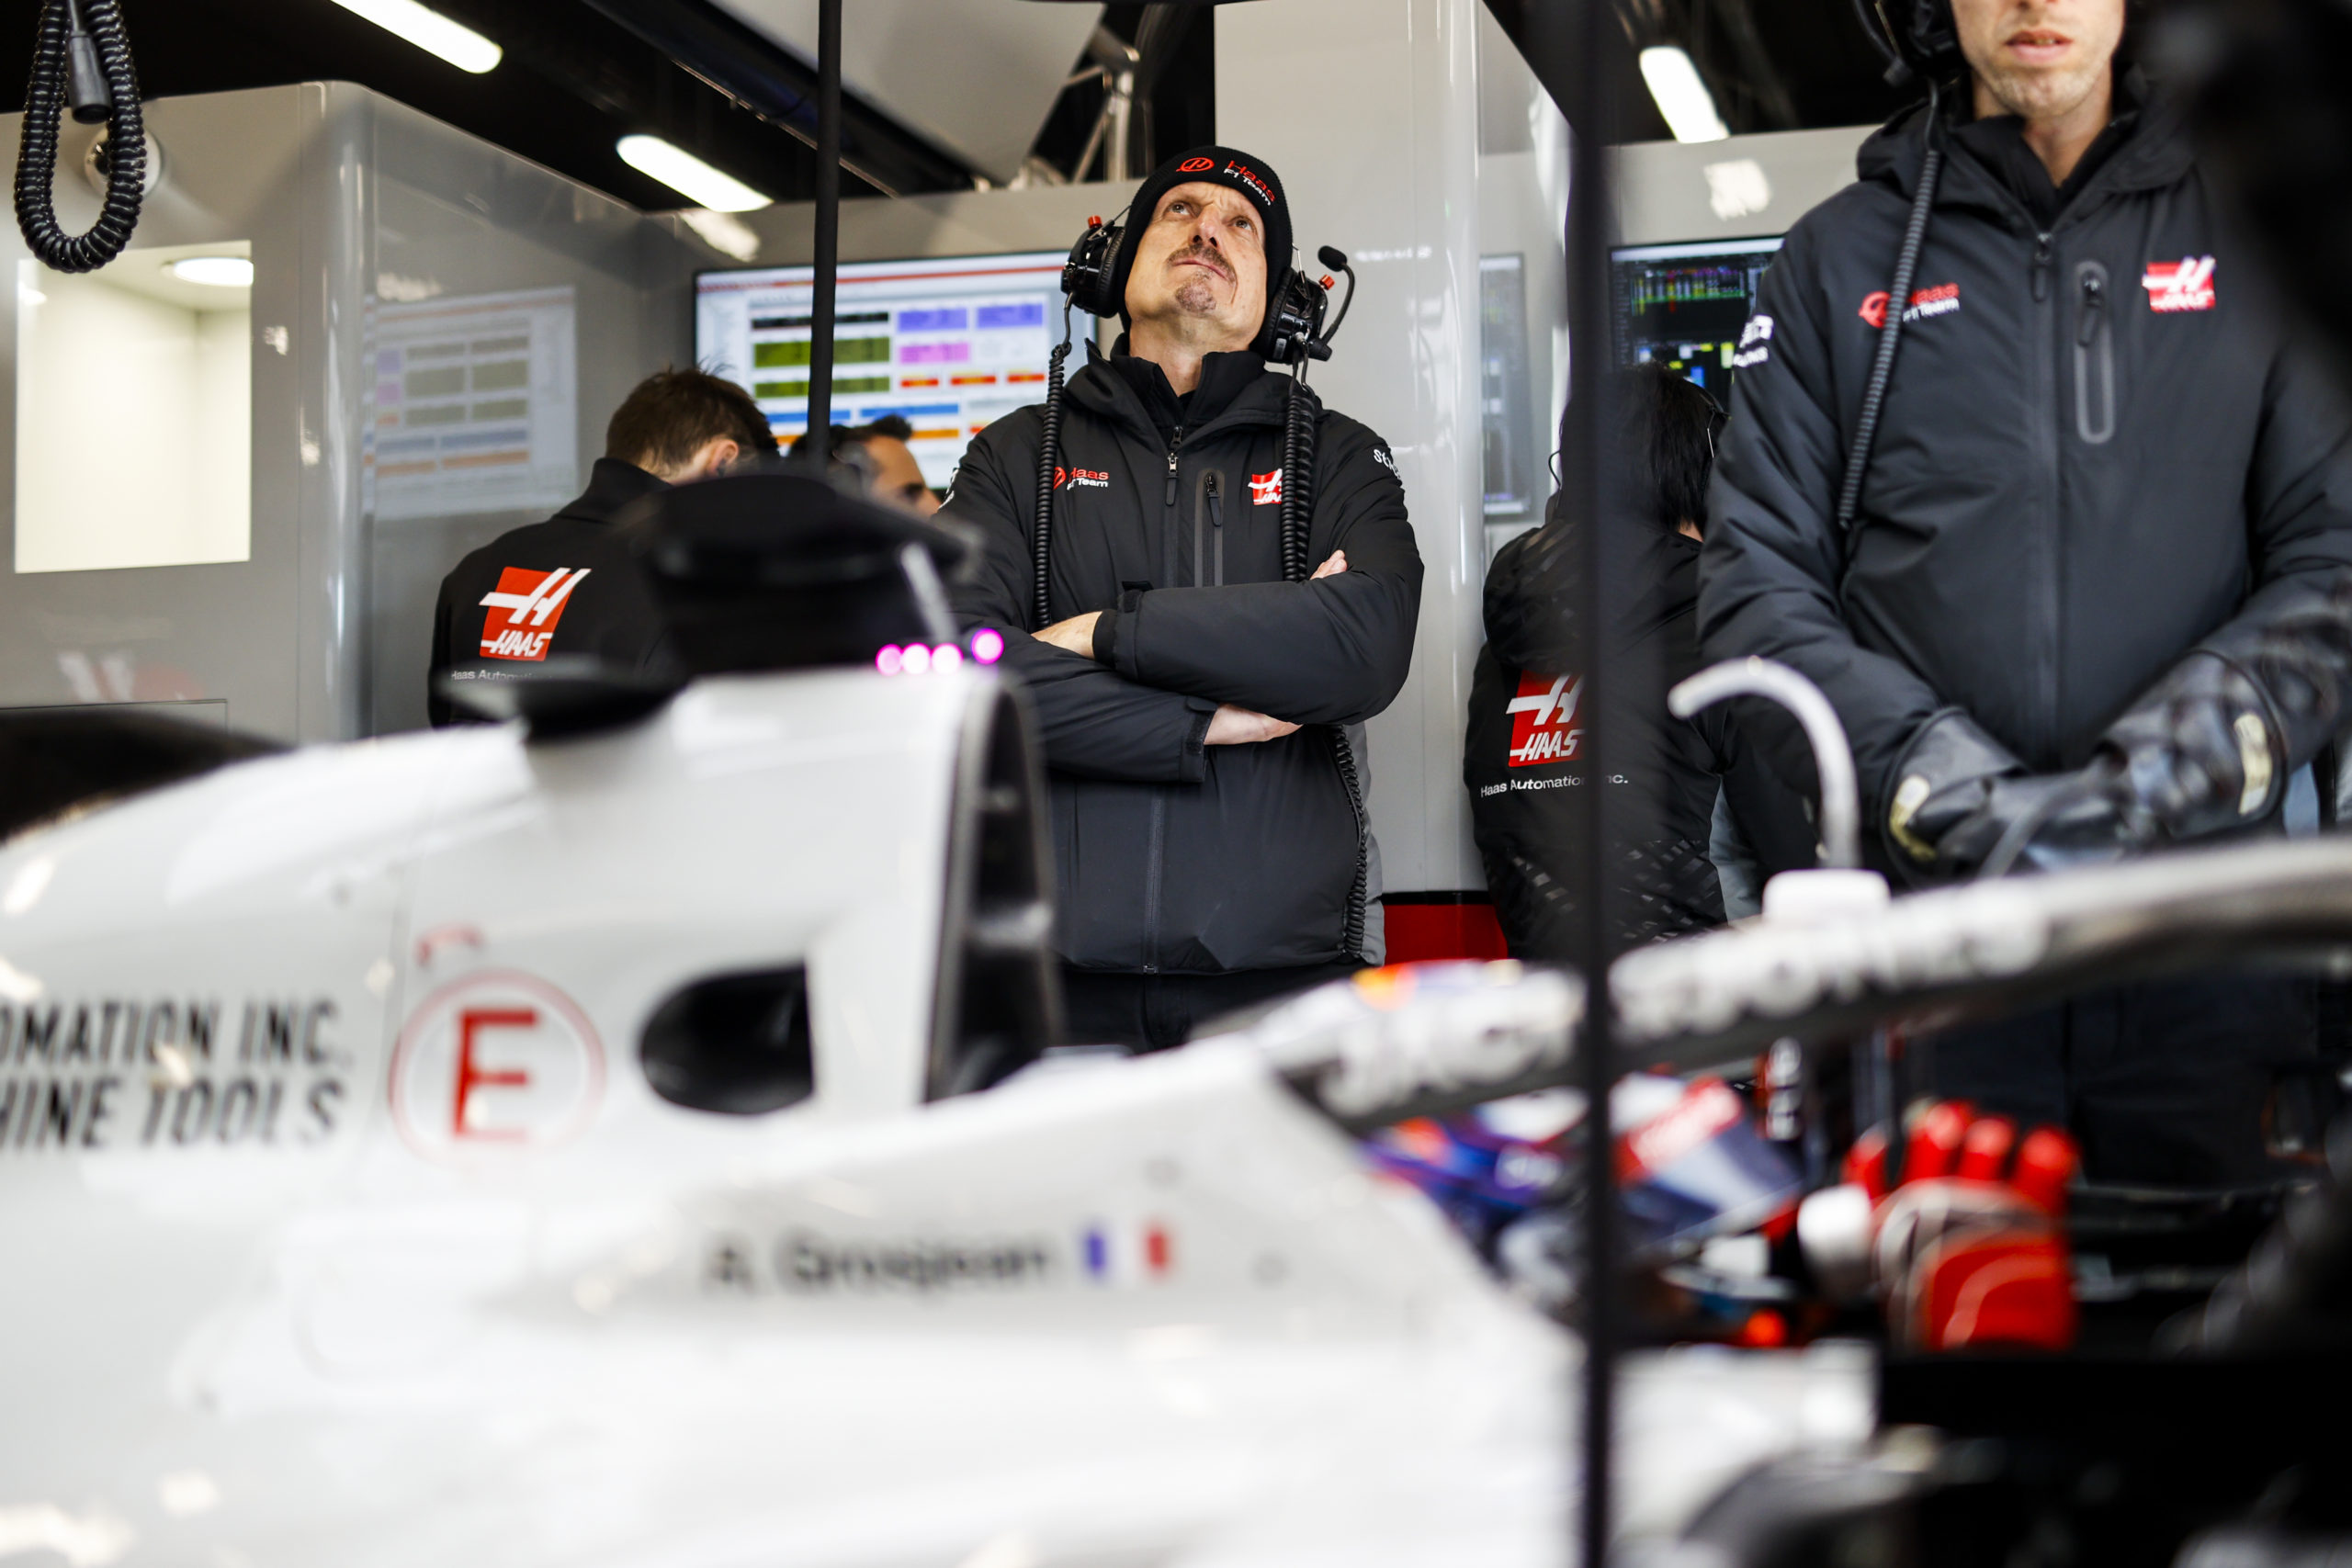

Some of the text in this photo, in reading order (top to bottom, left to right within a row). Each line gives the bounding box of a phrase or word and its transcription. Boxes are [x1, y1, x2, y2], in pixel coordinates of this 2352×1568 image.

[1223, 168, 1272, 206] F1 Team
[1227, 160, 1275, 202] Haas
[1918, 297, 1960, 317] Team
[1076, 478, 1109, 488] Team
[481, 629, 553, 657] HAAS
[1510, 728, 1587, 762] HAAS
[1480, 783, 1508, 798] Haas
[1510, 773, 1584, 791] Automatio
[452, 1005, 538, 1142] E
[142, 1077, 344, 1147] TOOLS
